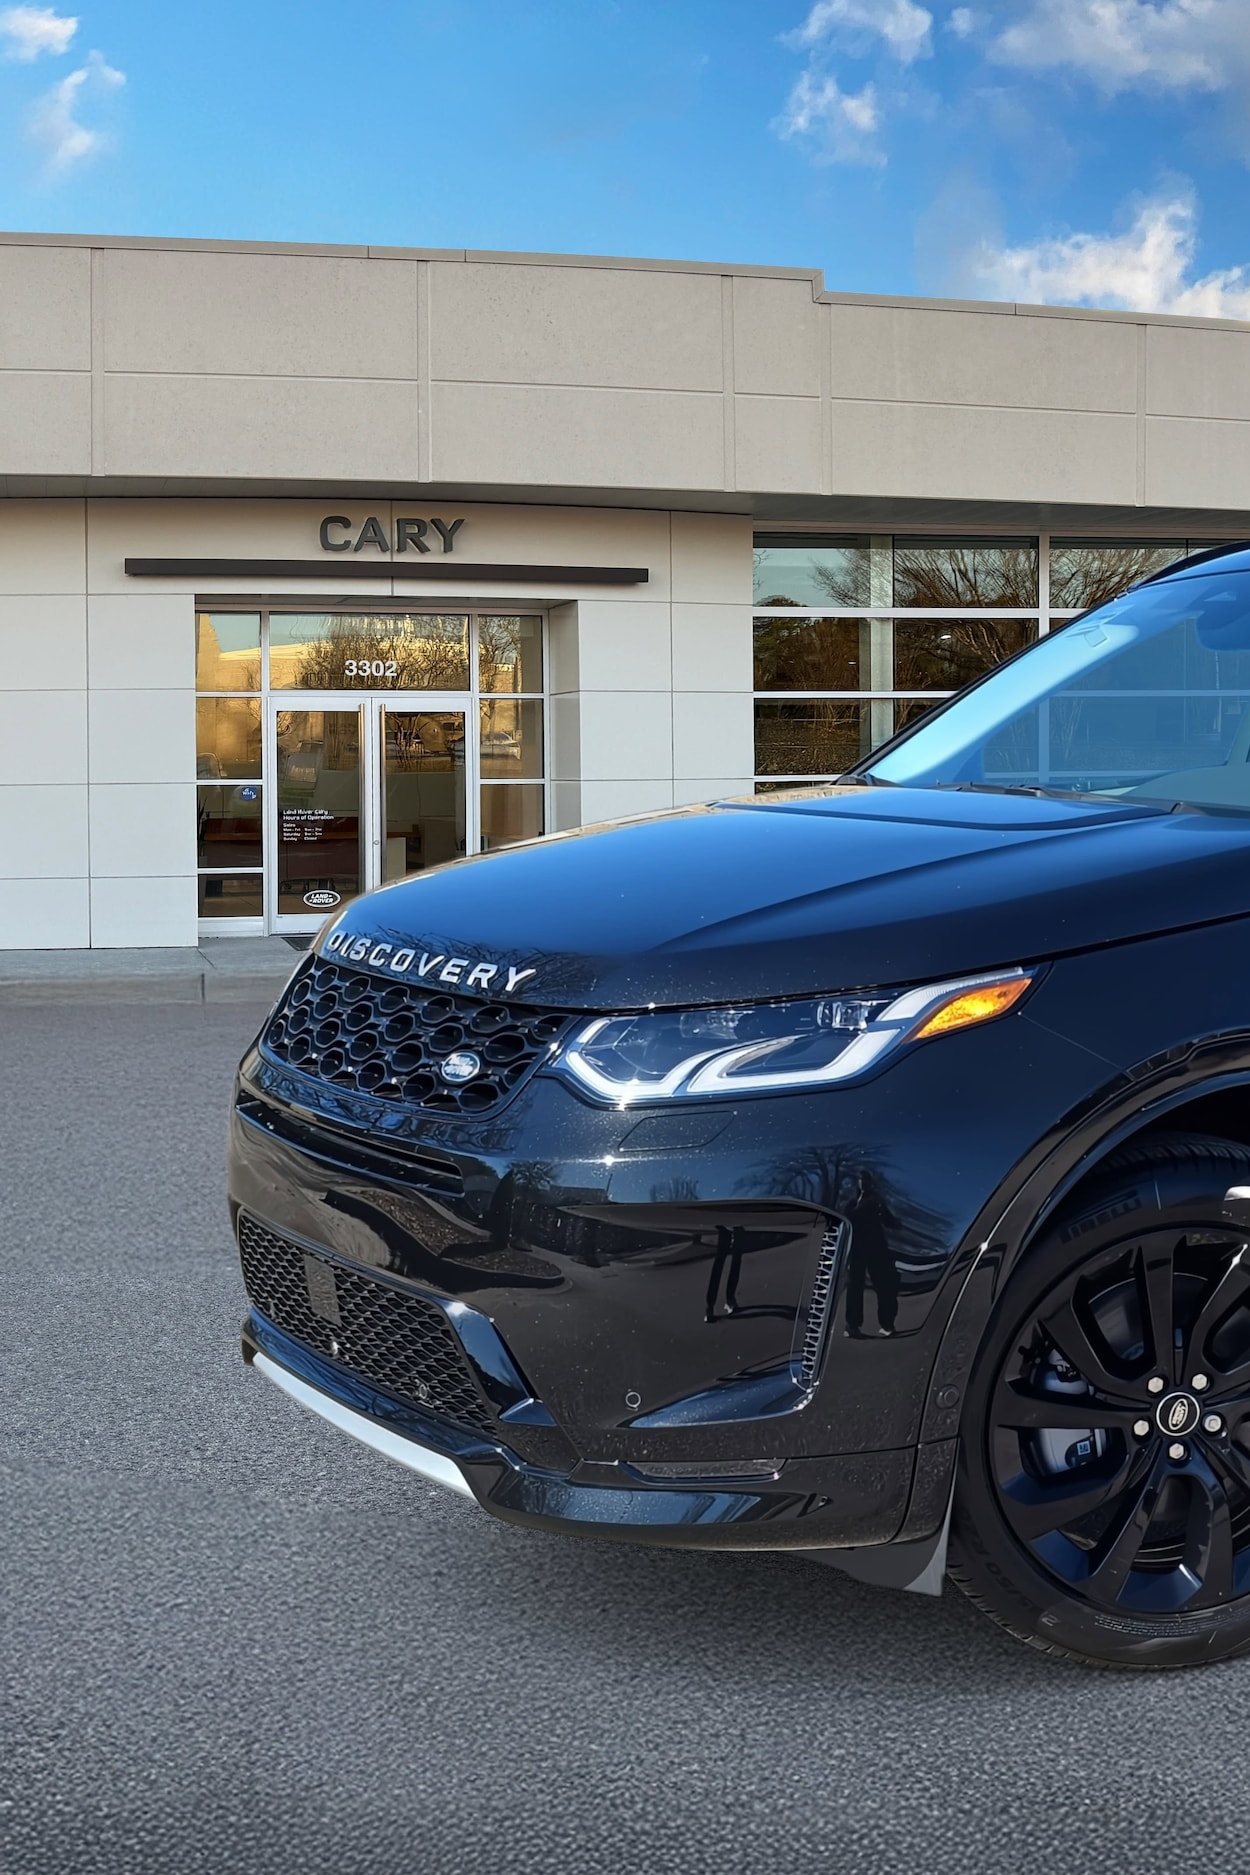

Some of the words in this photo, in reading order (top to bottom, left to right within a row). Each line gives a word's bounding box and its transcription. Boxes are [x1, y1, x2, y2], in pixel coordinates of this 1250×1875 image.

[319, 515, 466, 554] CARY
[344, 660, 397, 677] 3302
[327, 930, 537, 992] DISCOVERY
